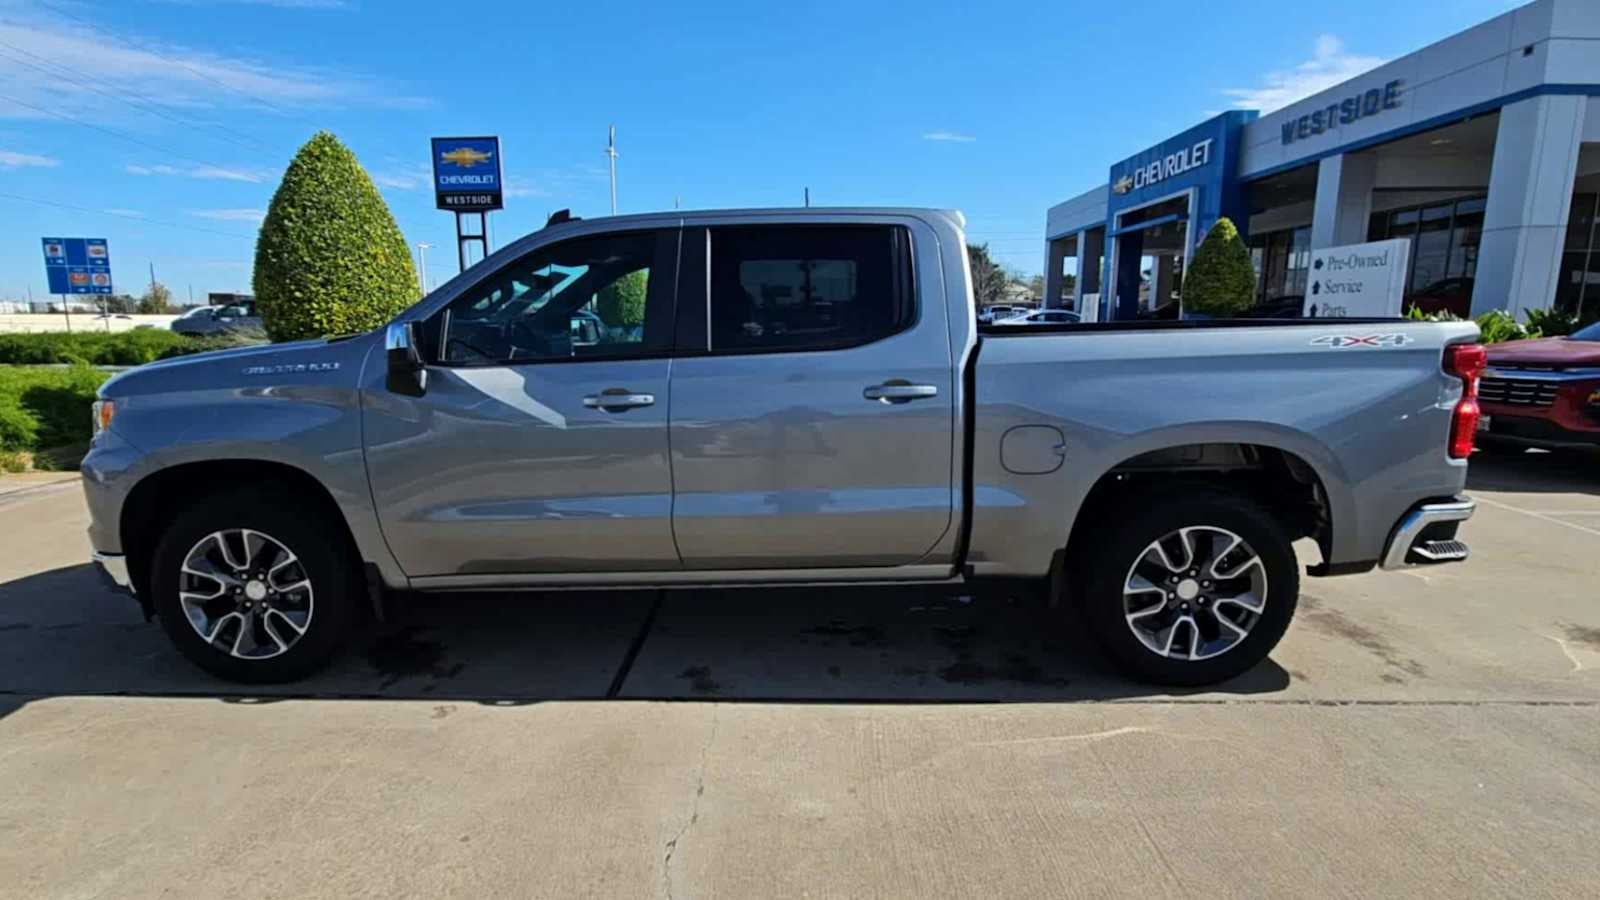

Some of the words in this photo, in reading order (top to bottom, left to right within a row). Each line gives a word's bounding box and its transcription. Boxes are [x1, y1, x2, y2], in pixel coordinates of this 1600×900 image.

[1281, 79, 1404, 146] WESTSIDE
[1133, 138, 1213, 190] CHEVROLET
[440, 174, 494, 185] CHEVROLET
[445, 195, 492, 205] WESTSIDE
[1328, 248, 1389, 271] Pre-Owned
[1323, 279, 1362, 294] Service
[1322, 303, 1347, 316] Parts
